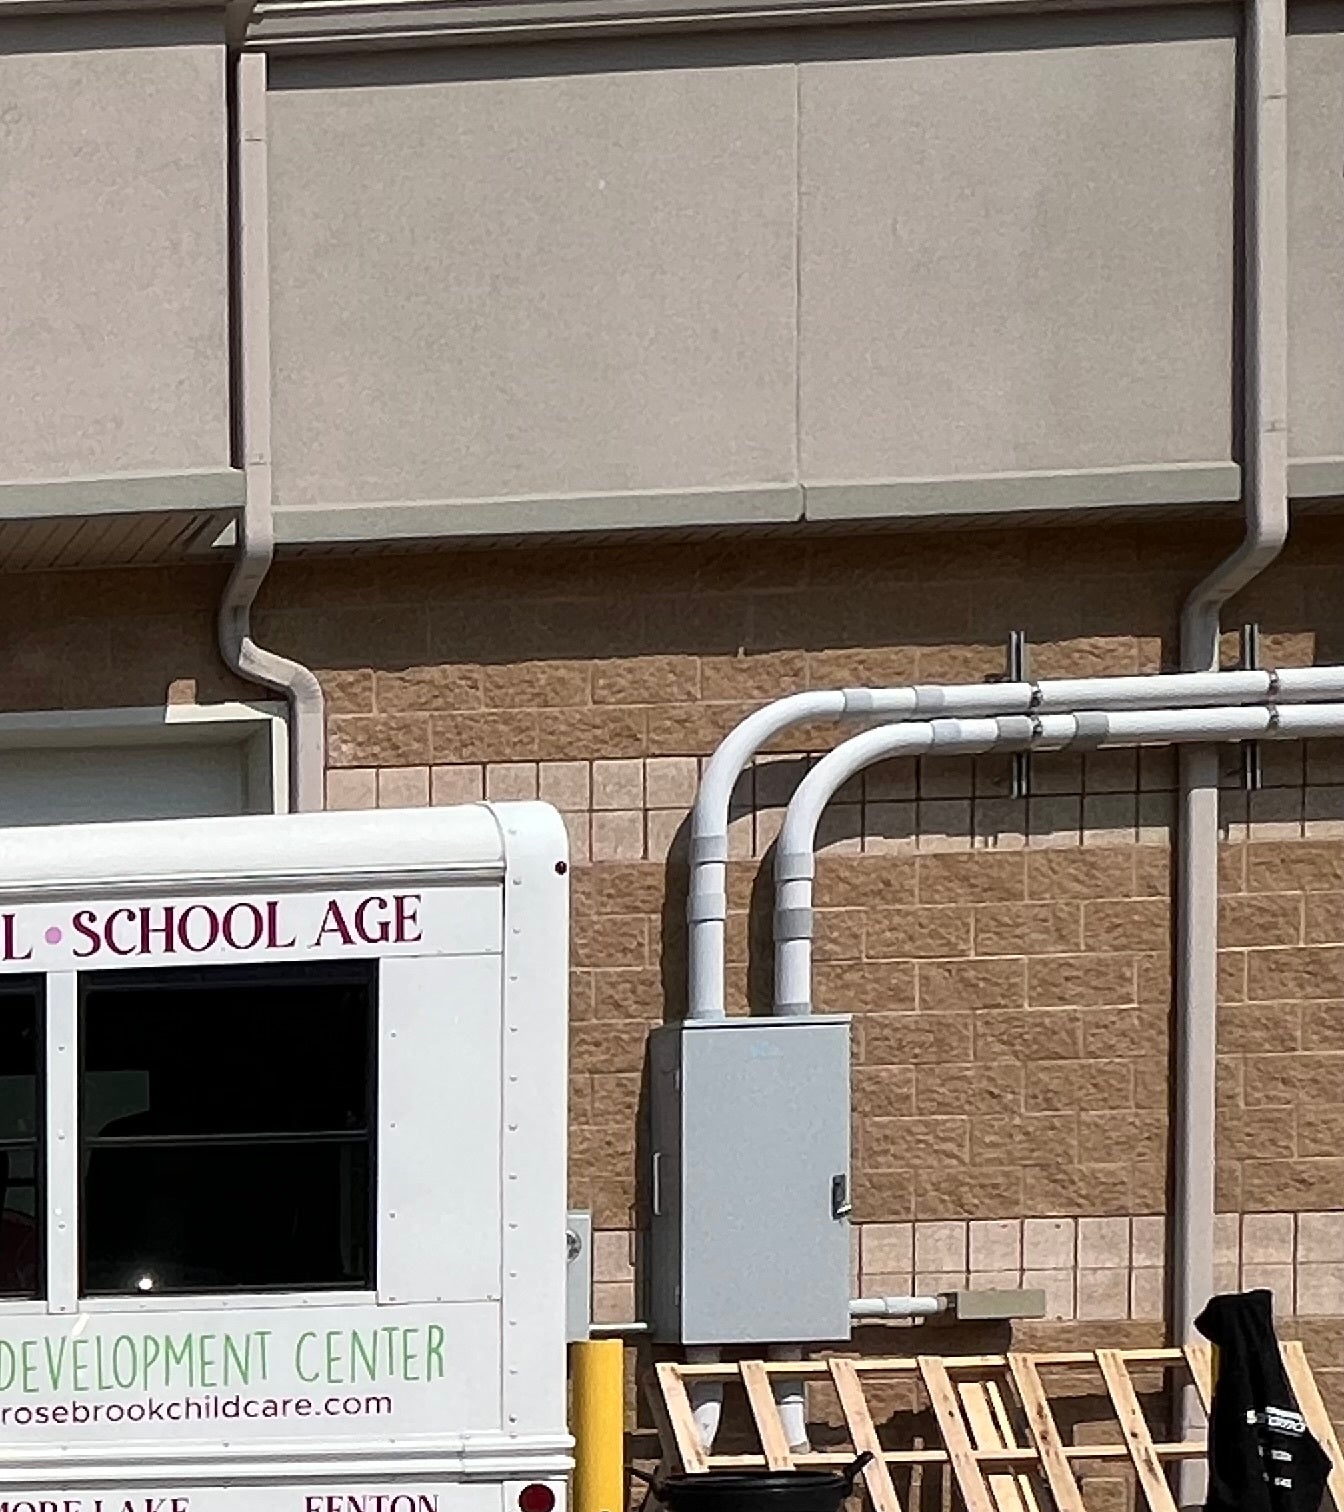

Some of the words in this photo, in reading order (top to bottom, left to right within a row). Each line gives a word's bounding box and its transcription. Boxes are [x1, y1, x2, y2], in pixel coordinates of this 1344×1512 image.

[72, 900, 297, 957] SCHOOL
[310, 894, 423, 948] AGE
[296, 1325, 444, 1383] CENTER
